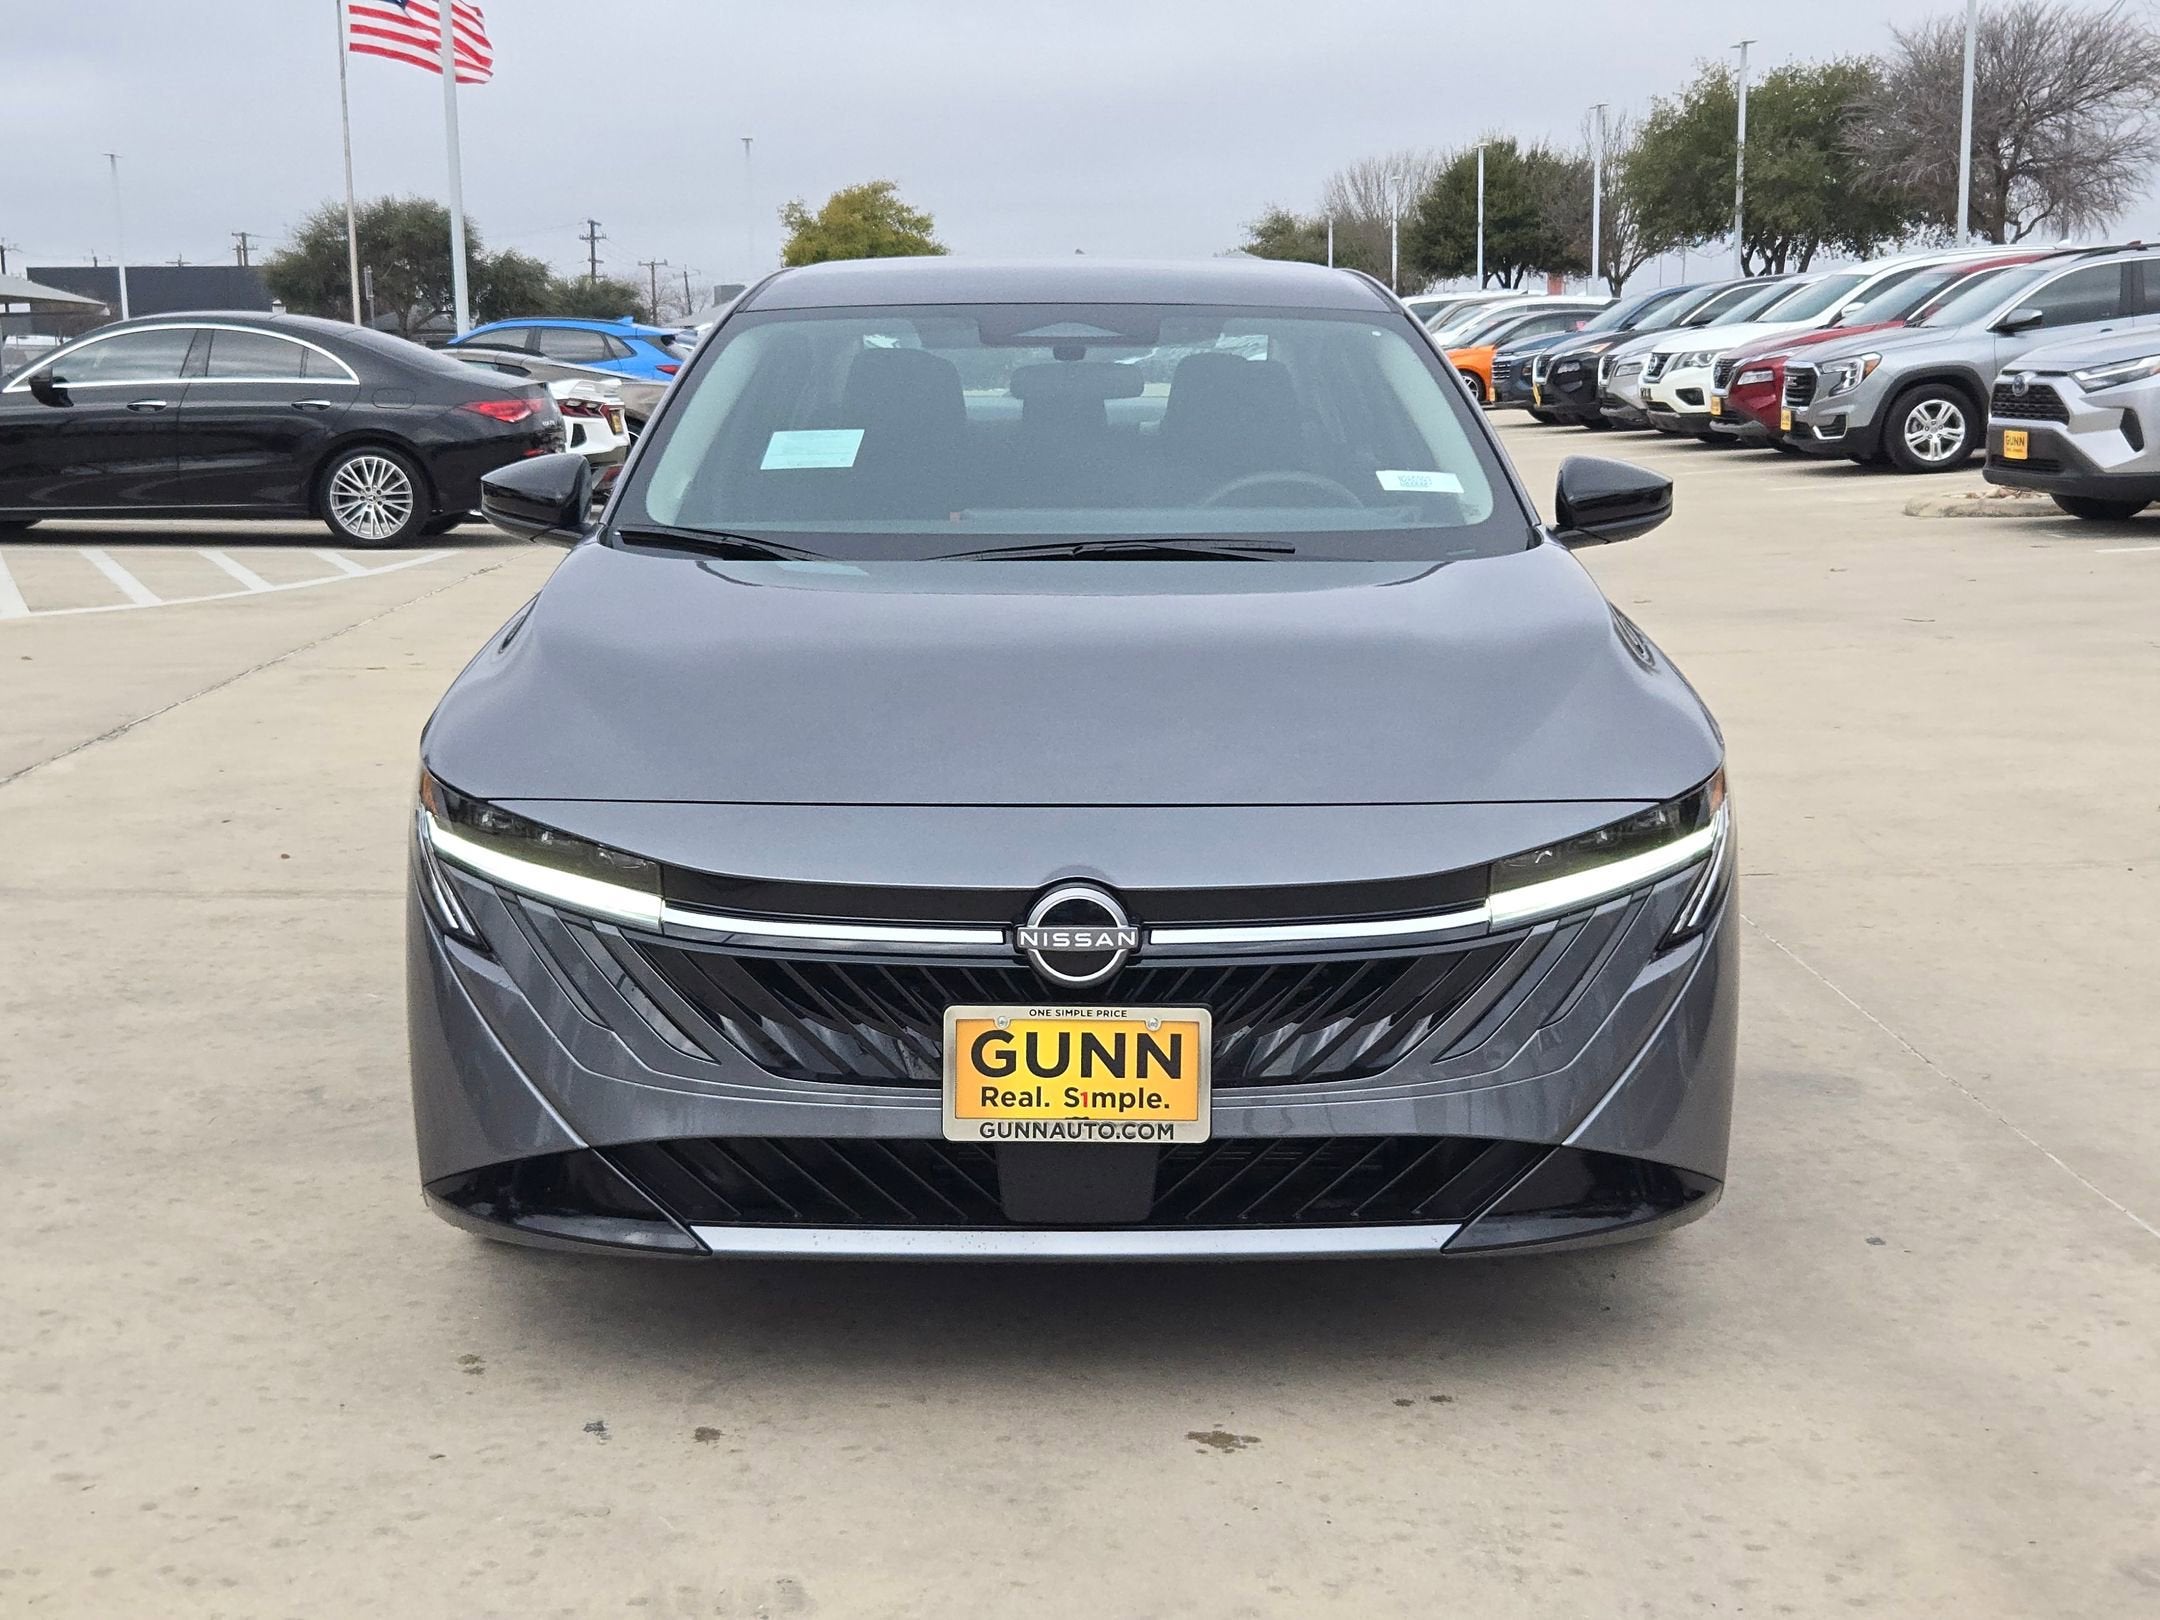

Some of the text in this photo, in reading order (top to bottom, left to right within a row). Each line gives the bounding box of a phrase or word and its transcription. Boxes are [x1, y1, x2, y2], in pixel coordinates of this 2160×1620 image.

[1020, 931, 1136, 947] NISSAN
[1029, 1009, 1128, 1018] ONE SIMPLE PRICE
[970, 1029, 1182, 1080] GUNN
[981, 1086, 1170, 1112] Real. S1mple.
[979, 1121, 1175, 1140] GUNNAUTO.COM
